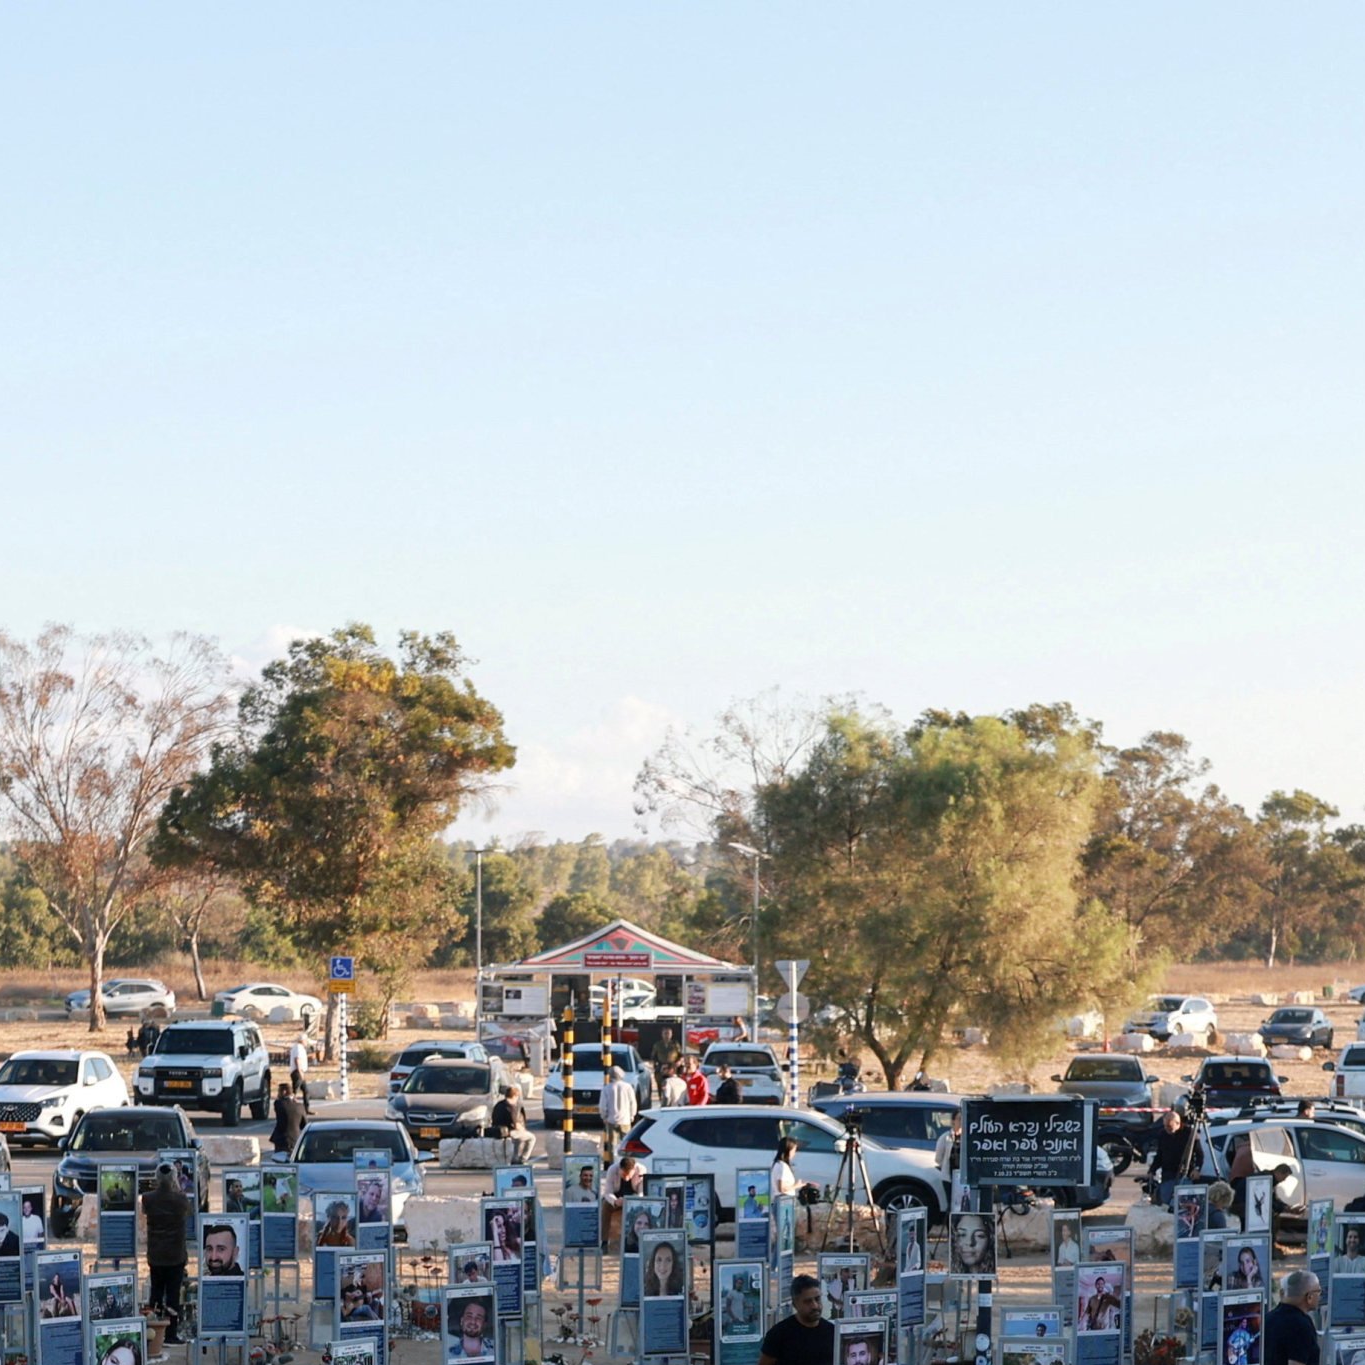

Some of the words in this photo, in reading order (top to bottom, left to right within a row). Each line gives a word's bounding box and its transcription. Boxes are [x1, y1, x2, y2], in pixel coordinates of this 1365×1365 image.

[970, 1114, 1003, 1134] העולם
[1009, 1120, 1039, 1137] נברא
[1045, 1114, 1081, 1133] בשבילי
[973, 1138, 1007, 1151] ואפר
[1011, 1138, 1038, 1150] עפר
[1043, 1138, 1077, 1154] ואנוכי
